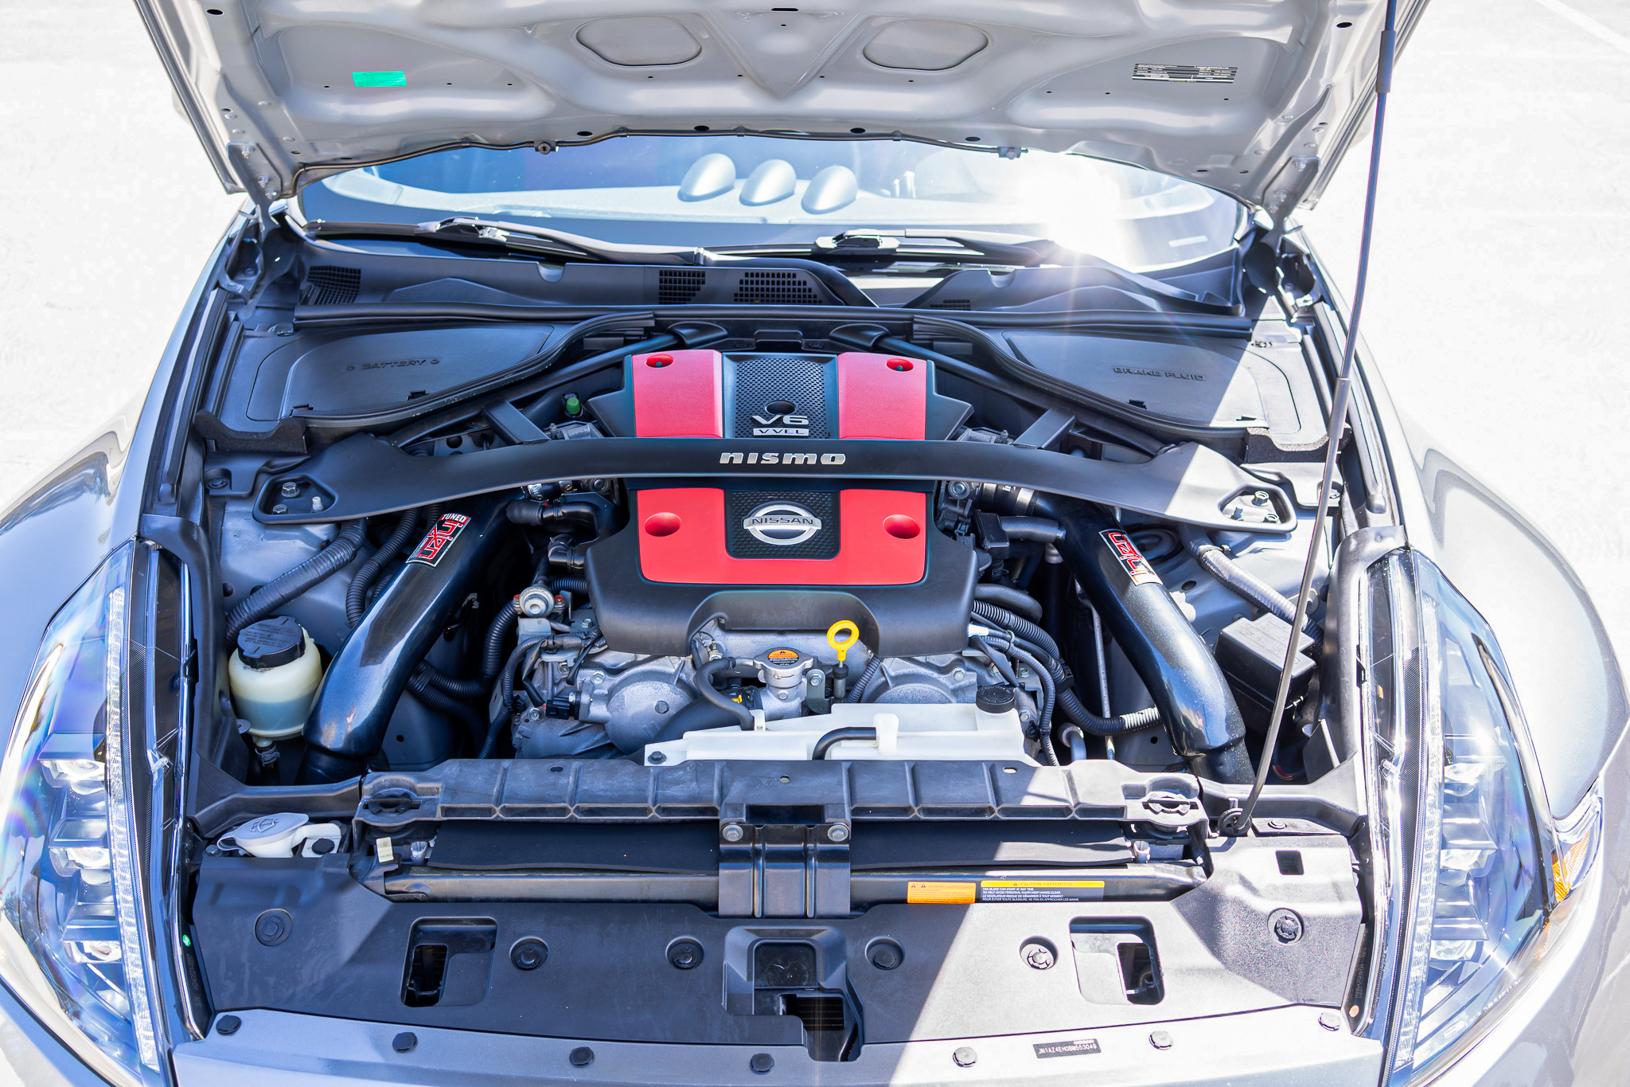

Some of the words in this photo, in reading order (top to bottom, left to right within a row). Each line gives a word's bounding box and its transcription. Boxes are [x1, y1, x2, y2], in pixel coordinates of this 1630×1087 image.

[751, 414, 810, 426] V6
[719, 452, 847, 465] nismo
[441, 513, 467, 523] TUNED
[751, 516, 815, 525] NISSAN
